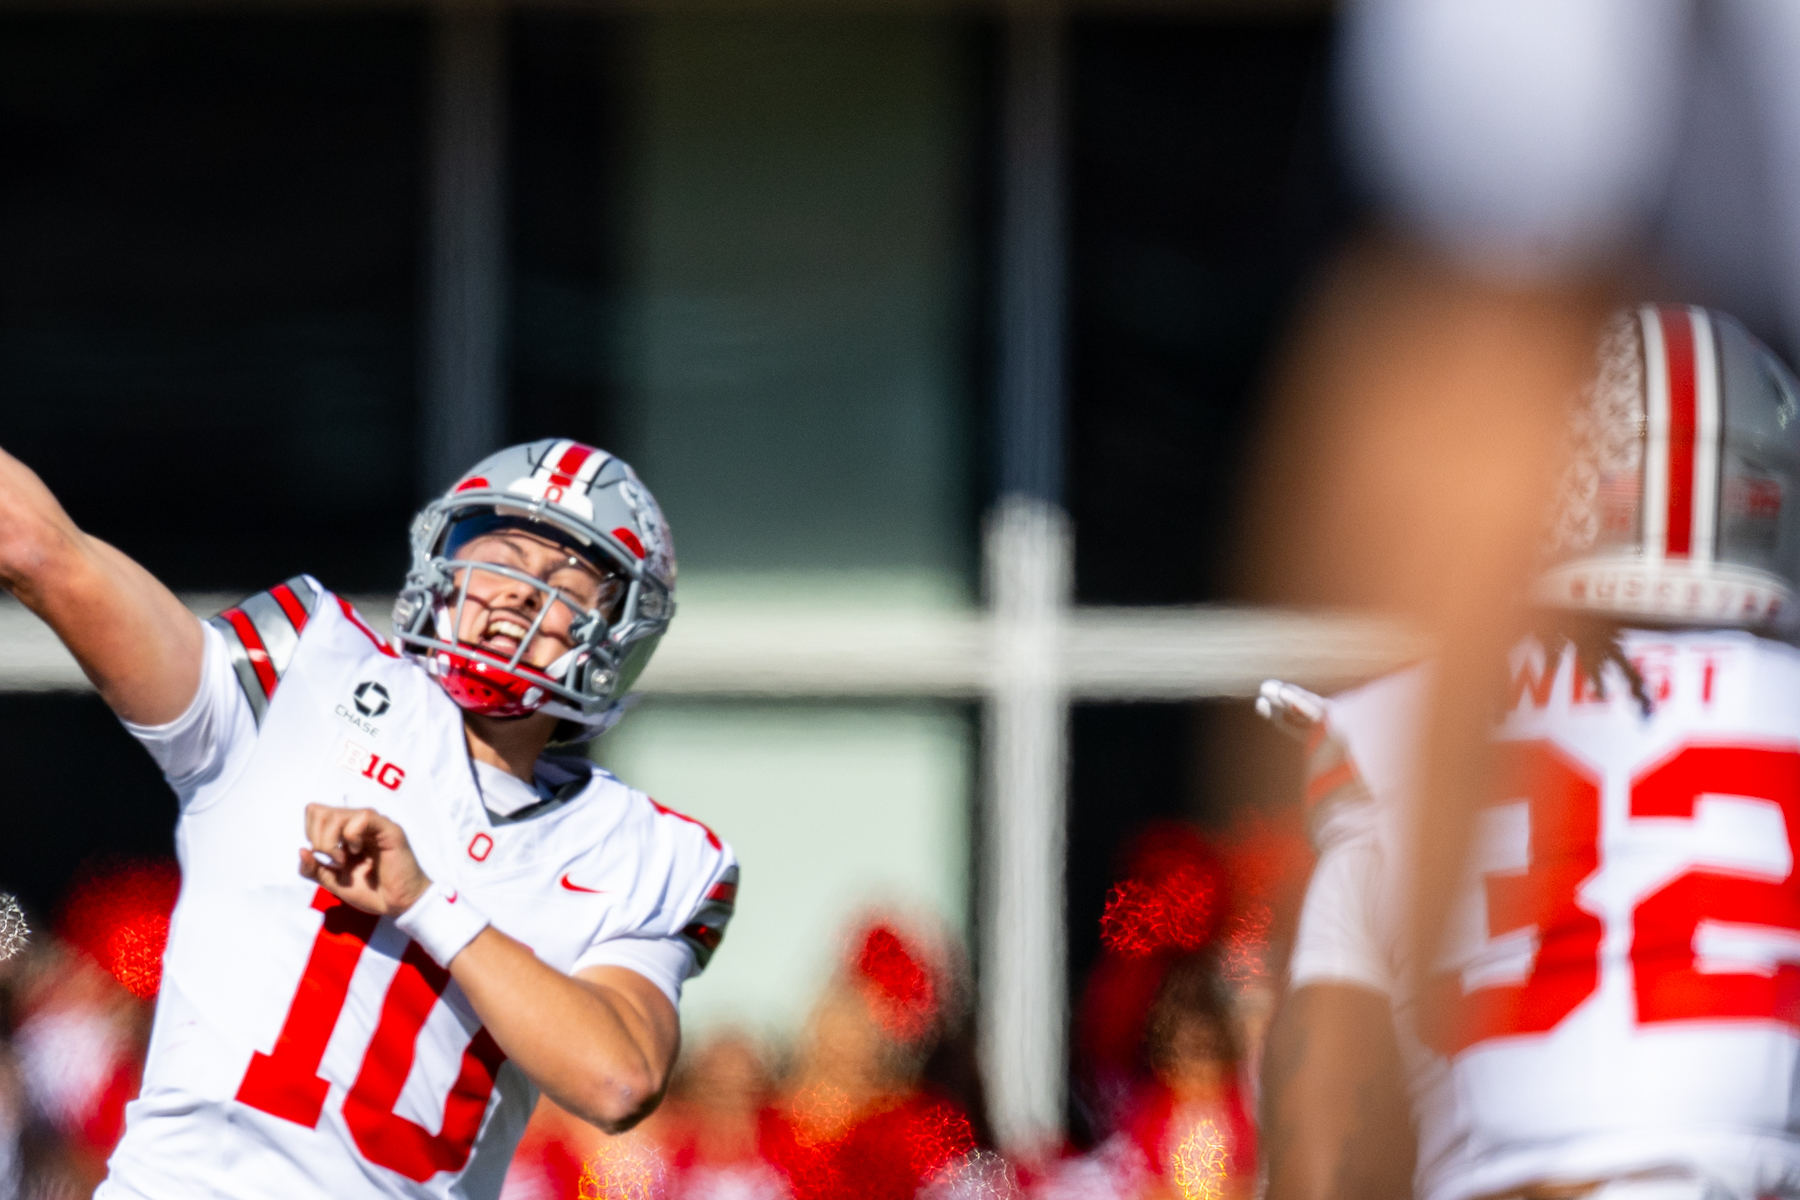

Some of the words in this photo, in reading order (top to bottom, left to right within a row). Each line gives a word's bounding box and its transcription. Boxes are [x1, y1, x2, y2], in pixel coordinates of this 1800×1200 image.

[334, 703, 380, 738] CHASE
[234, 885, 522, 1184] 10
[1436, 733, 1800, 1062] 32
